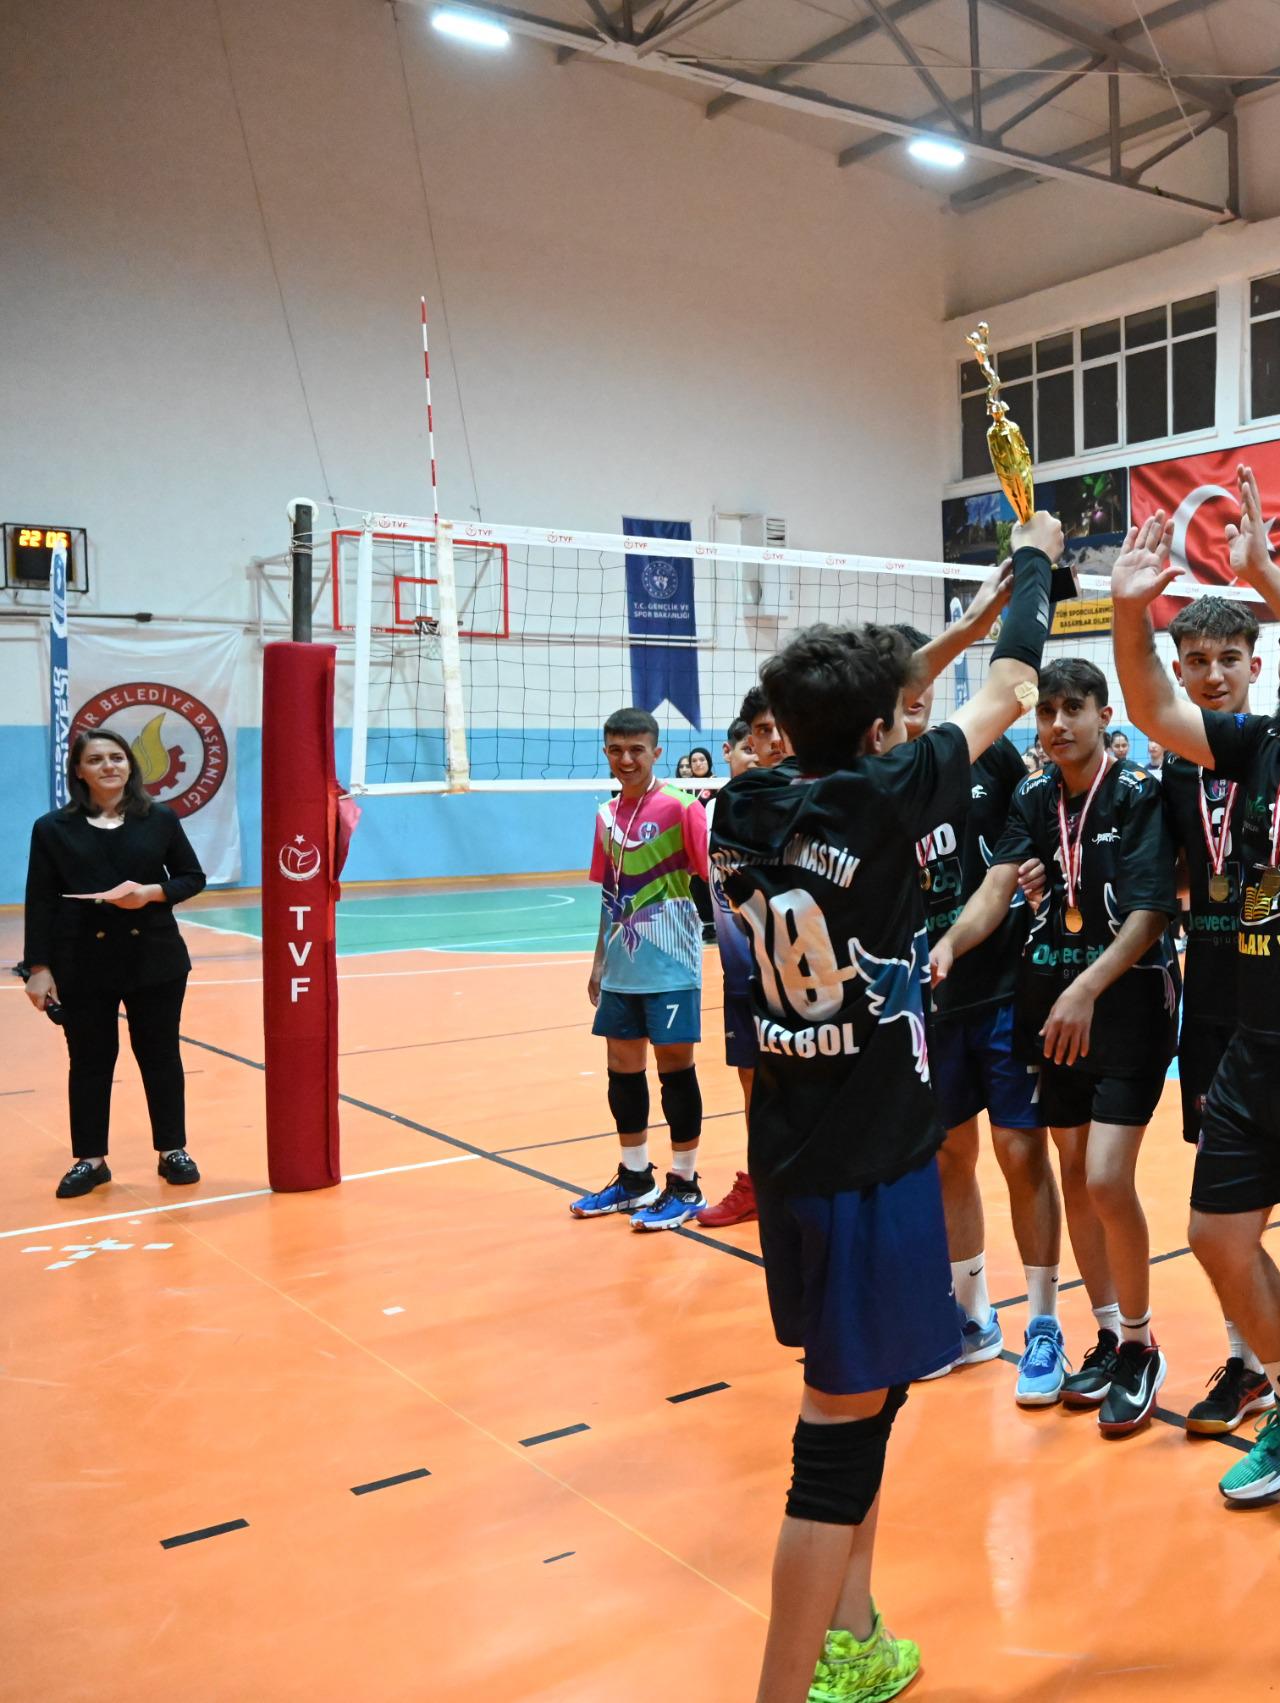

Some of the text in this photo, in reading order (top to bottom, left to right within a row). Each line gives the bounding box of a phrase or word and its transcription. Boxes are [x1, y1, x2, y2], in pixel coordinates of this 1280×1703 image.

[392, 521, 408, 530] TVF
[478, 529, 493, 537] TVF
[19, 530, 42, 547] 22
[558, 535, 573, 544] TVF
[634, 541, 649, 550] TVF
[100, 687, 221, 808] BELEDİYE BAŞKANLIĞI
[665, 1004, 679, 1029] 7
